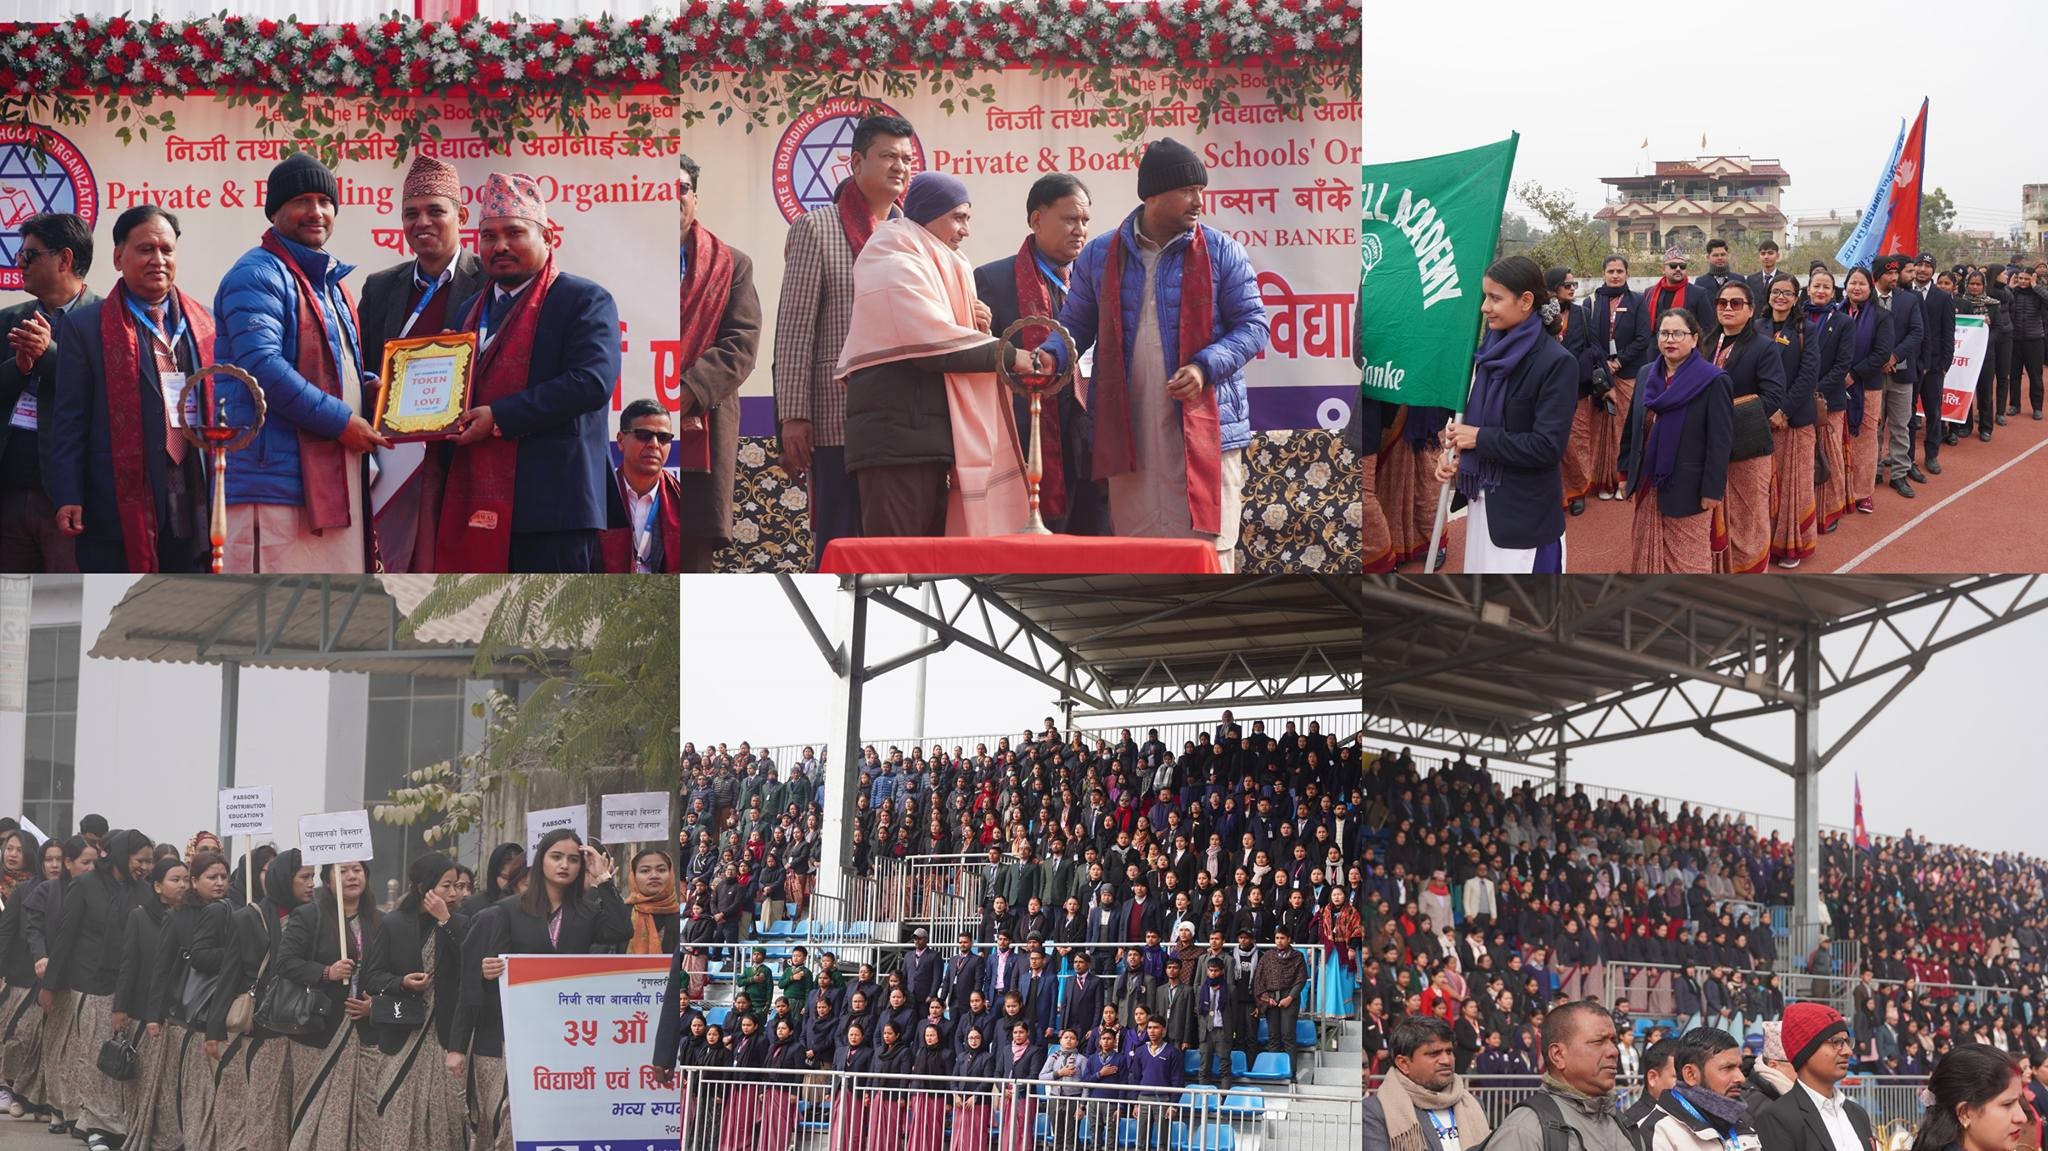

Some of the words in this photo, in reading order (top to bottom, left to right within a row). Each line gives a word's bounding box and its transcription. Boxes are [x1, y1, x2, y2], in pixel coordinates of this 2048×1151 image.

[591, 102, 611, 119] be
[616, 103, 674, 119] Uited
[986, 104, 1045, 131] निजी
[1051, 109, 1096, 131] तथा
[1313, 96, 1361, 122] अर्ग
[165, 134, 230, 163] निजी
[236, 139, 290, 162] तथा
[777, 114, 815, 170] BOARDING
[934, 149, 1029, 175] Private
[1037, 146, 1061, 173] &
[1204, 138, 1315, 168] Schools'
[106, 181, 211, 210] Private
[220, 179, 247, 208] &
[1292, 178, 1354, 214] बाँके
[1274, 227, 1357, 247] BANKE
[1362, 182, 1390, 223] LL
[1391, 187, 1463, 310] ACADEMY
[412, 376, 447, 385] TOKEN
[422, 387, 437, 395] OF
[414, 398, 442, 407] LOVE
[542, 818, 572, 828] PABSON'S
[558, 991, 582, 1005] निजी
[586, 994, 606, 1005] तथा
[610, 991, 652, 1005] आवासीय
[563, 1019, 599, 1047] ३५
[533, 1065, 597, 1090] विद्यार्थी
[605, 1066, 630, 1090] एवं
[612, 1102, 646, 1116] भव्य
